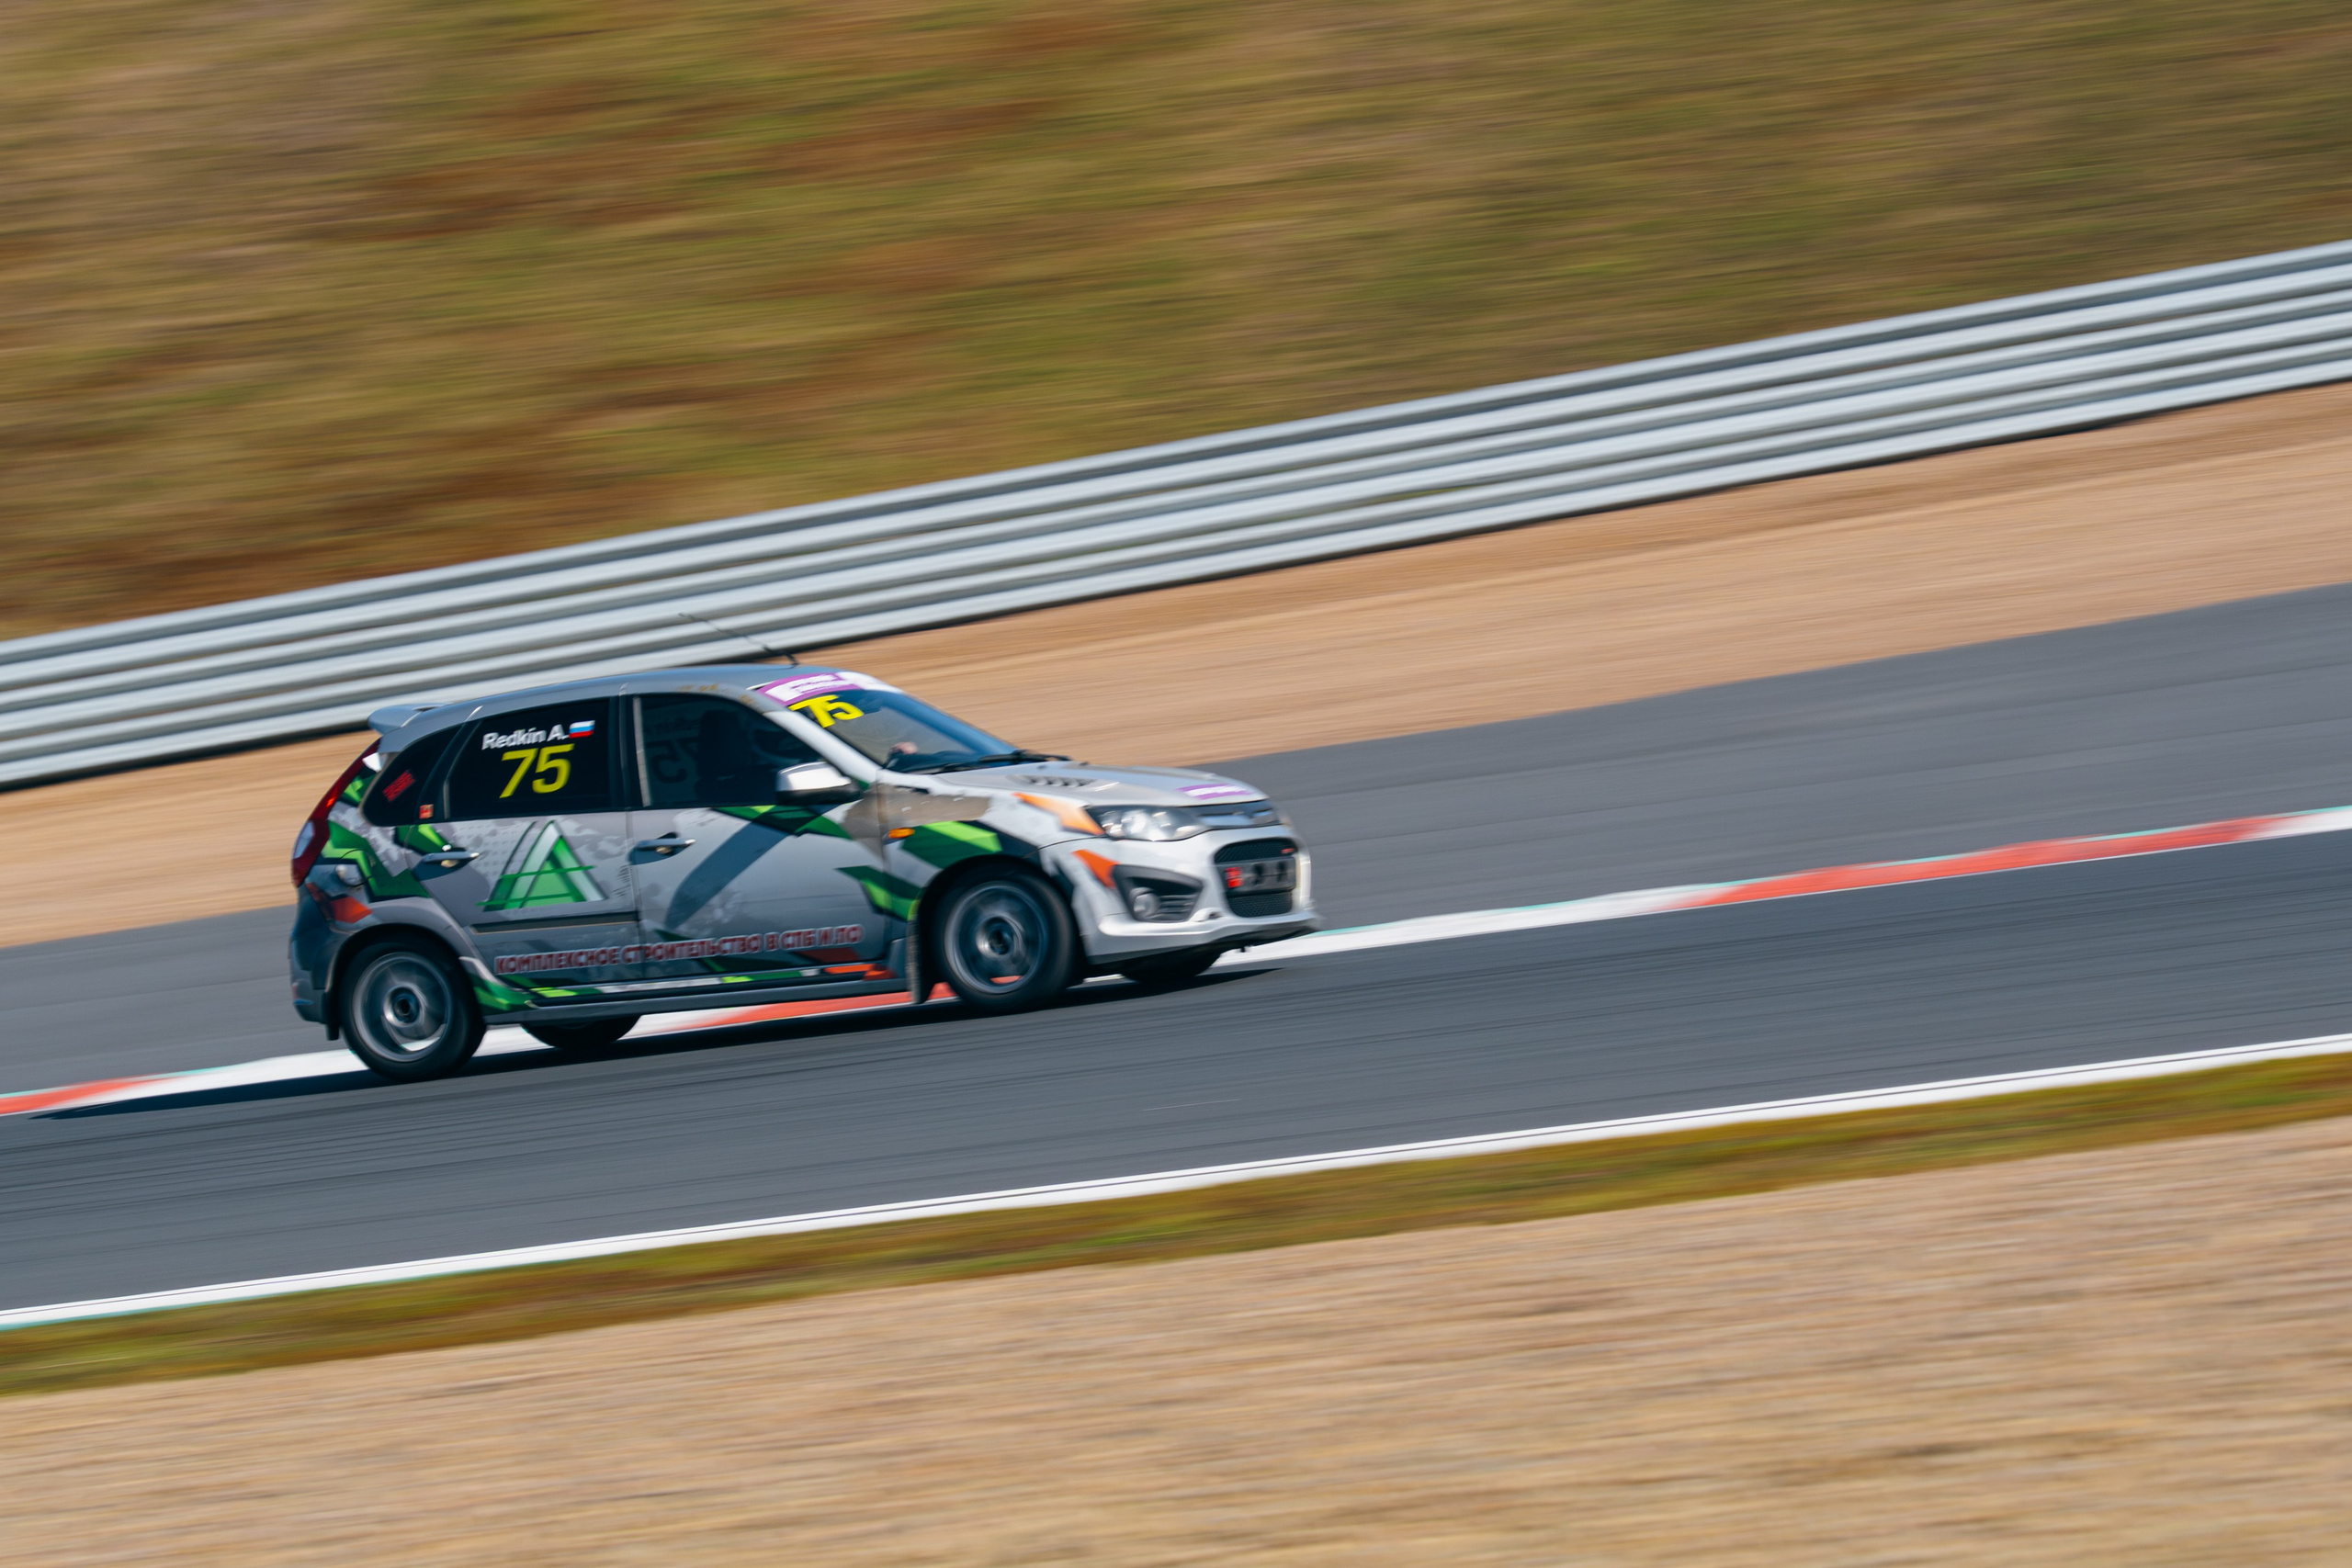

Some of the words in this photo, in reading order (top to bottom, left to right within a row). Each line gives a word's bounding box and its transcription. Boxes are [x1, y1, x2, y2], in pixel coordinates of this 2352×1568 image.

[787, 694, 864, 728] 75
[481, 727, 547, 750] Redkin
[499, 743, 575, 799] 75
[494, 946, 621, 975] КОМПЛЕКСНОЕ
[622, 933, 763, 964] СТРОИТЕЛЬСТВО
